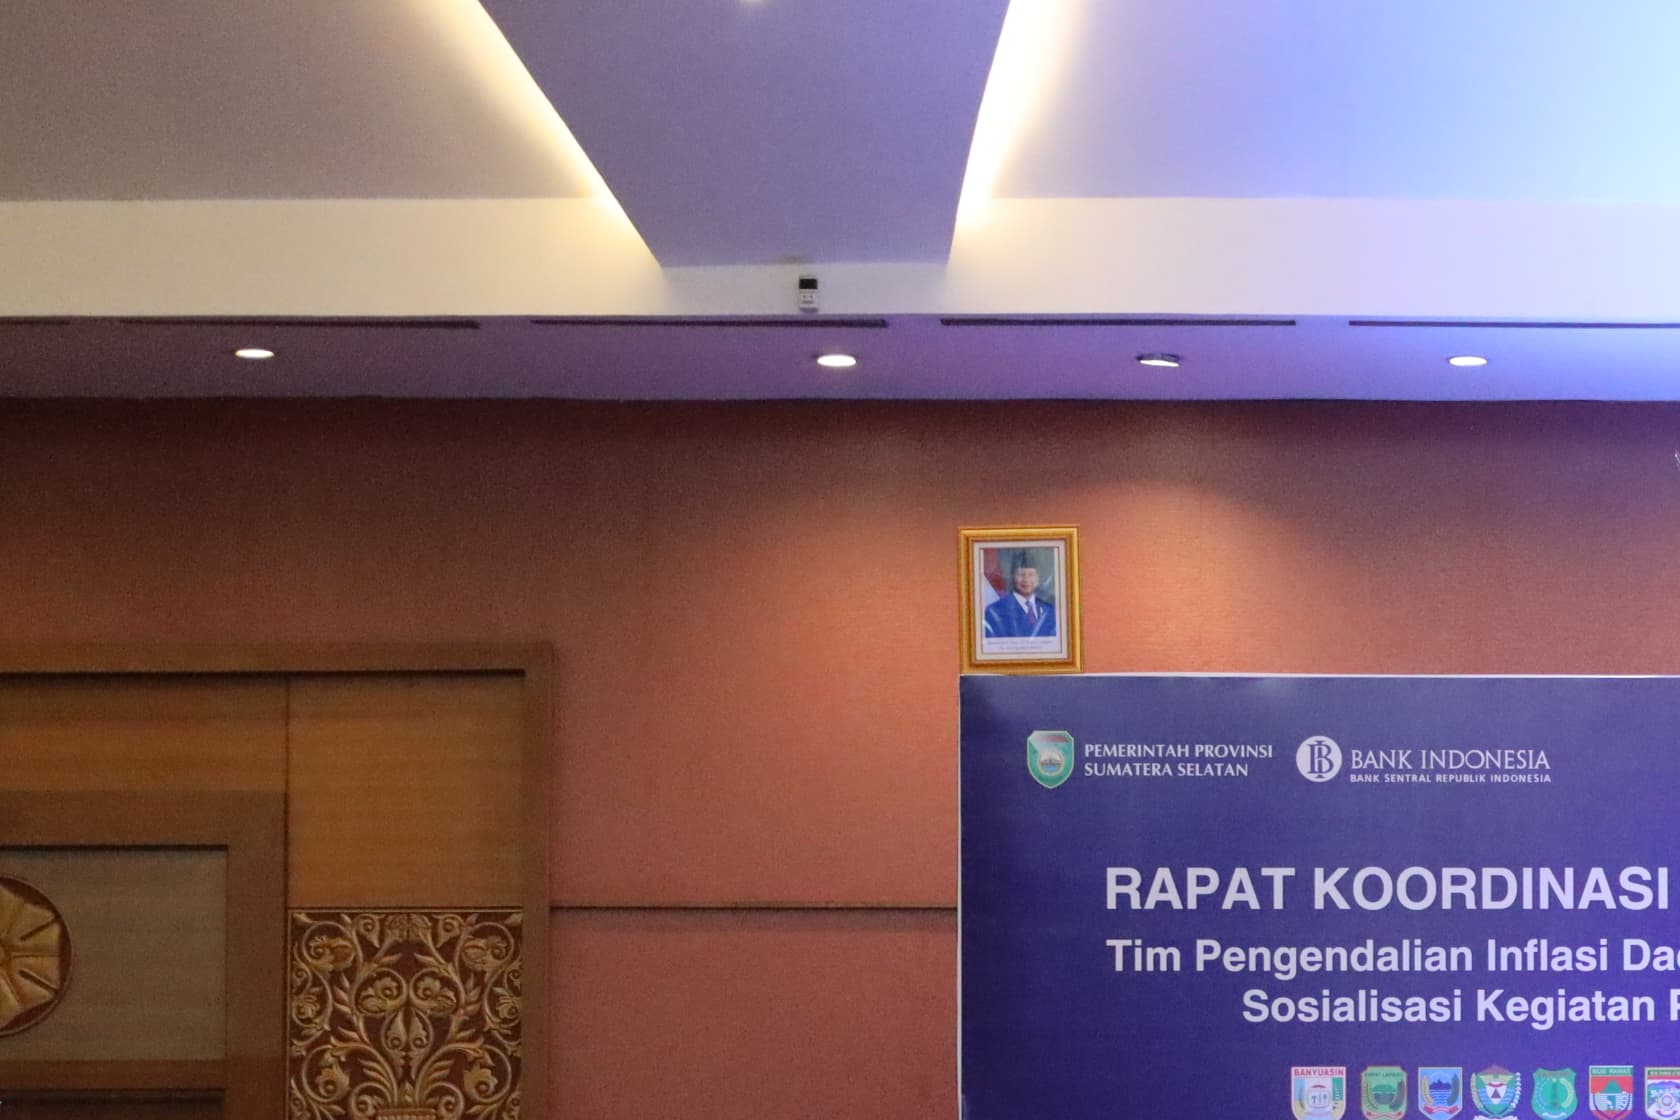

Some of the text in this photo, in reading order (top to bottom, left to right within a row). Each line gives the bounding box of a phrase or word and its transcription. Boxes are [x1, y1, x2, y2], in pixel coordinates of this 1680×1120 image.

[1084, 744, 1273, 758] PEMERINTAH PROVINSI
[1351, 749, 1551, 770] BANK INDONESIA
[1084, 762, 1248, 777] SUMATERA SELATAN
[1350, 773, 1551, 783] BANK SENTRAL REPUBLIK INDONESIA
[1106, 867, 1296, 910] RAPAT
[1314, 866, 1669, 910] KOORDINASI
[1106, 939, 1181, 972] Tim
[1196, 938, 1473, 981] Pengendalian
[1487, 938, 1608, 972] Inflasi
[1243, 988, 1462, 1023] Sosialisasi
[1477, 988, 1655, 1031] Kegiatan
[1294, 1068, 1344, 1076] BANYUASIN
